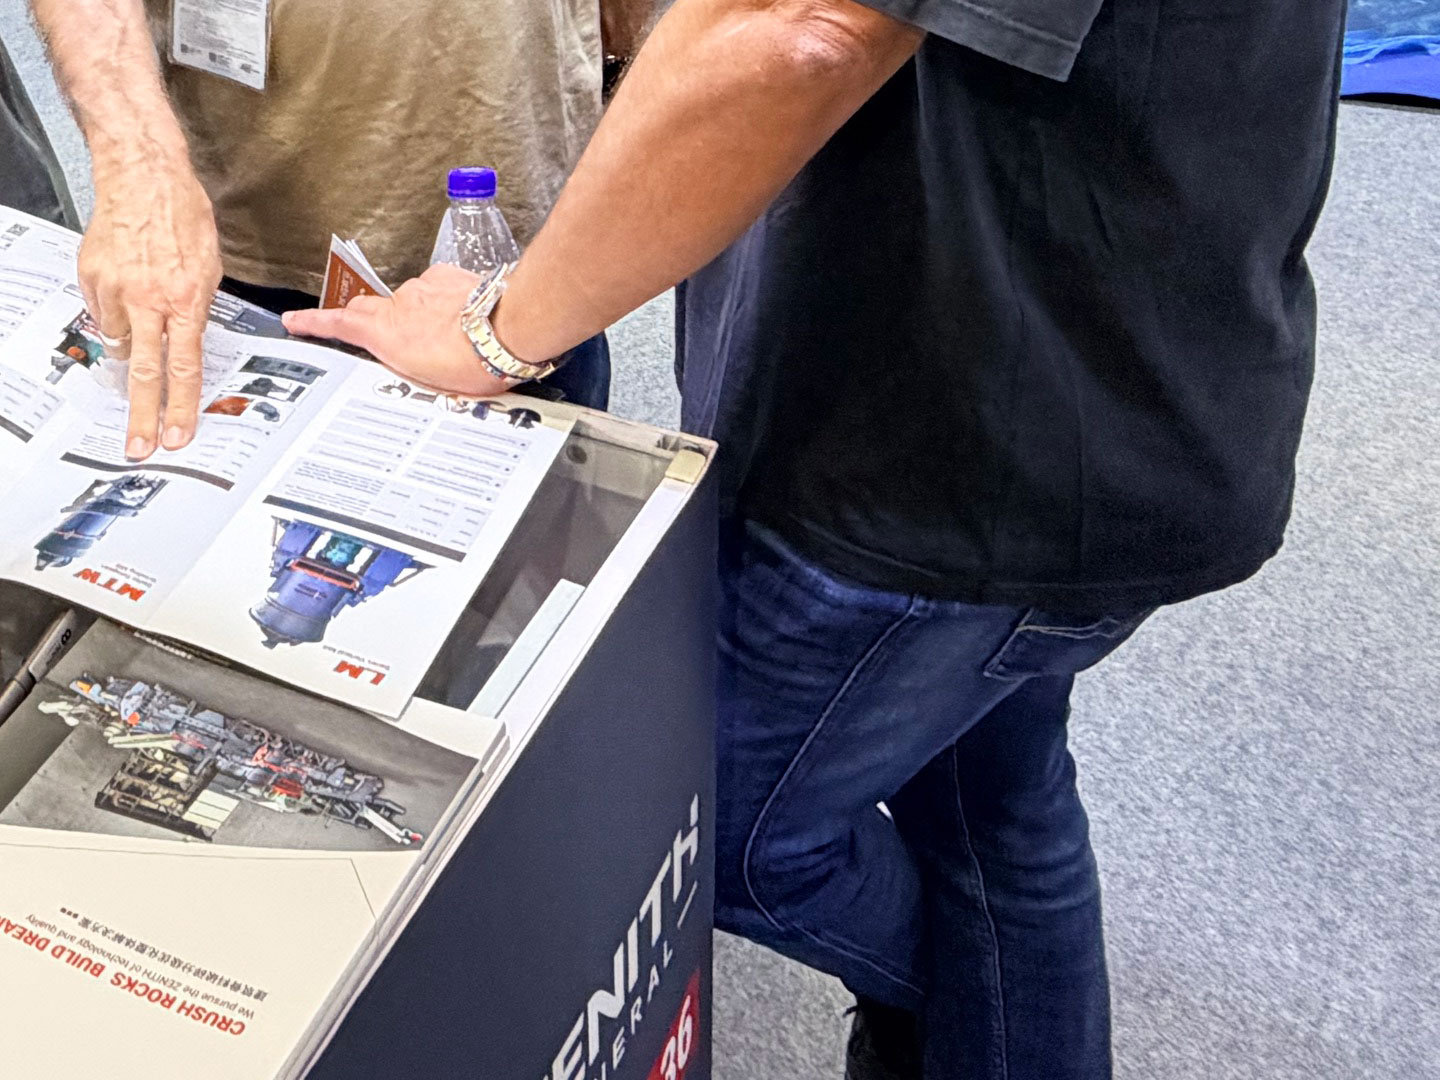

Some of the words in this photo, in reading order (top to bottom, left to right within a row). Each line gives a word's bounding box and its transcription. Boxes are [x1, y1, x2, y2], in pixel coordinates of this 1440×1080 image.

[73, 568, 146, 602] MTW
[333, 660, 386, 686] LM
[25, 913, 58, 933] quality
[60, 930, 76, 943] and
[538, 792, 699, 1080] ENITH
[51, 944, 106, 978] BUILD
[77, 937, 131, 969] technology
[131, 962, 142, 974] of
[142, 967, 182, 992] ZENITH
[110, 971, 177, 1009] ROCKS
[182, 985, 200, 1001] the
[201, 992, 239, 1013] pursue
[177, 999, 246, 1037] CRUSH
[239, 1006, 255, 1020] We
